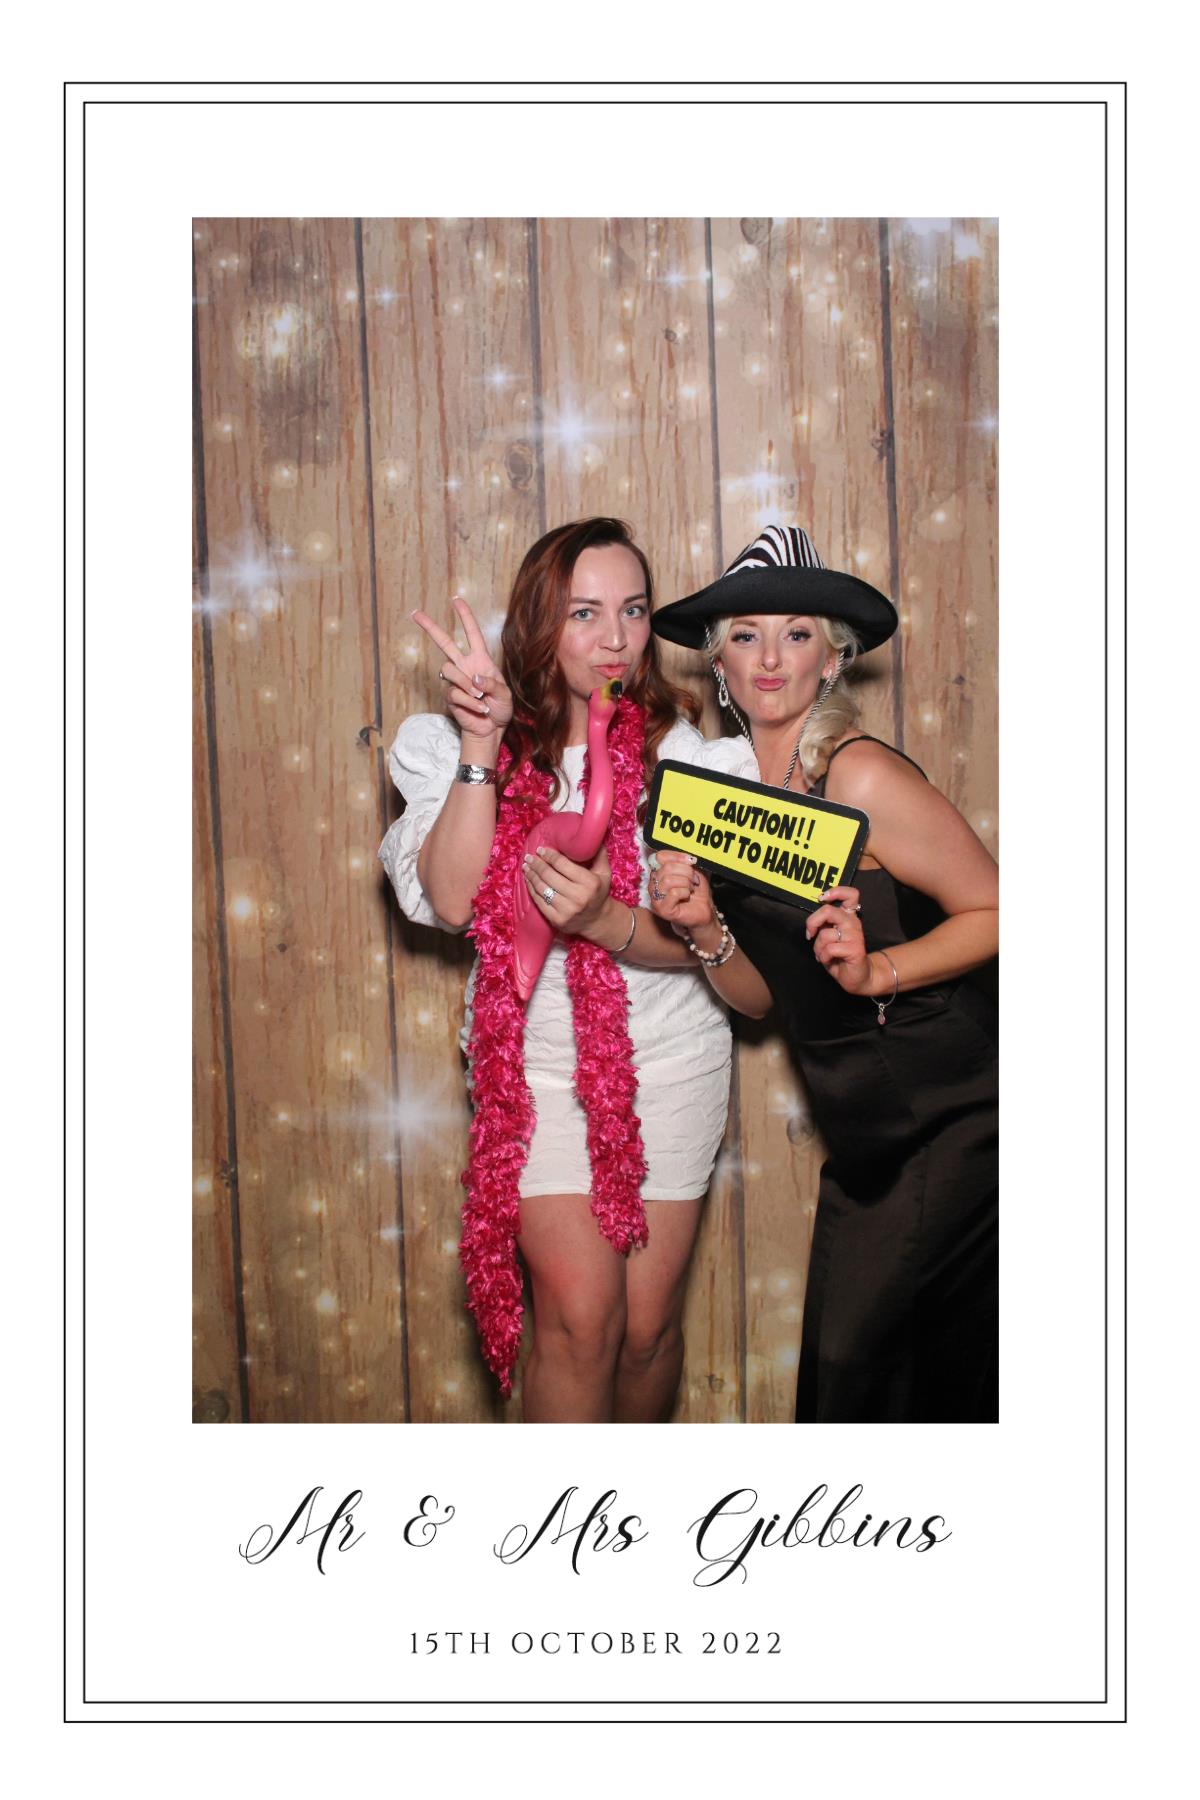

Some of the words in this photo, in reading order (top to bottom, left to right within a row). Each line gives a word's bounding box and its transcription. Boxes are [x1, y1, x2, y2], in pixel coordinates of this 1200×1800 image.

[660, 809, 695, 838] TOO
[696, 822, 736, 853] HOT
[737, 835, 761, 864] TO
[762, 845, 839, 891] HANDLE
[713, 798, 816, 849] CAUTION!!
